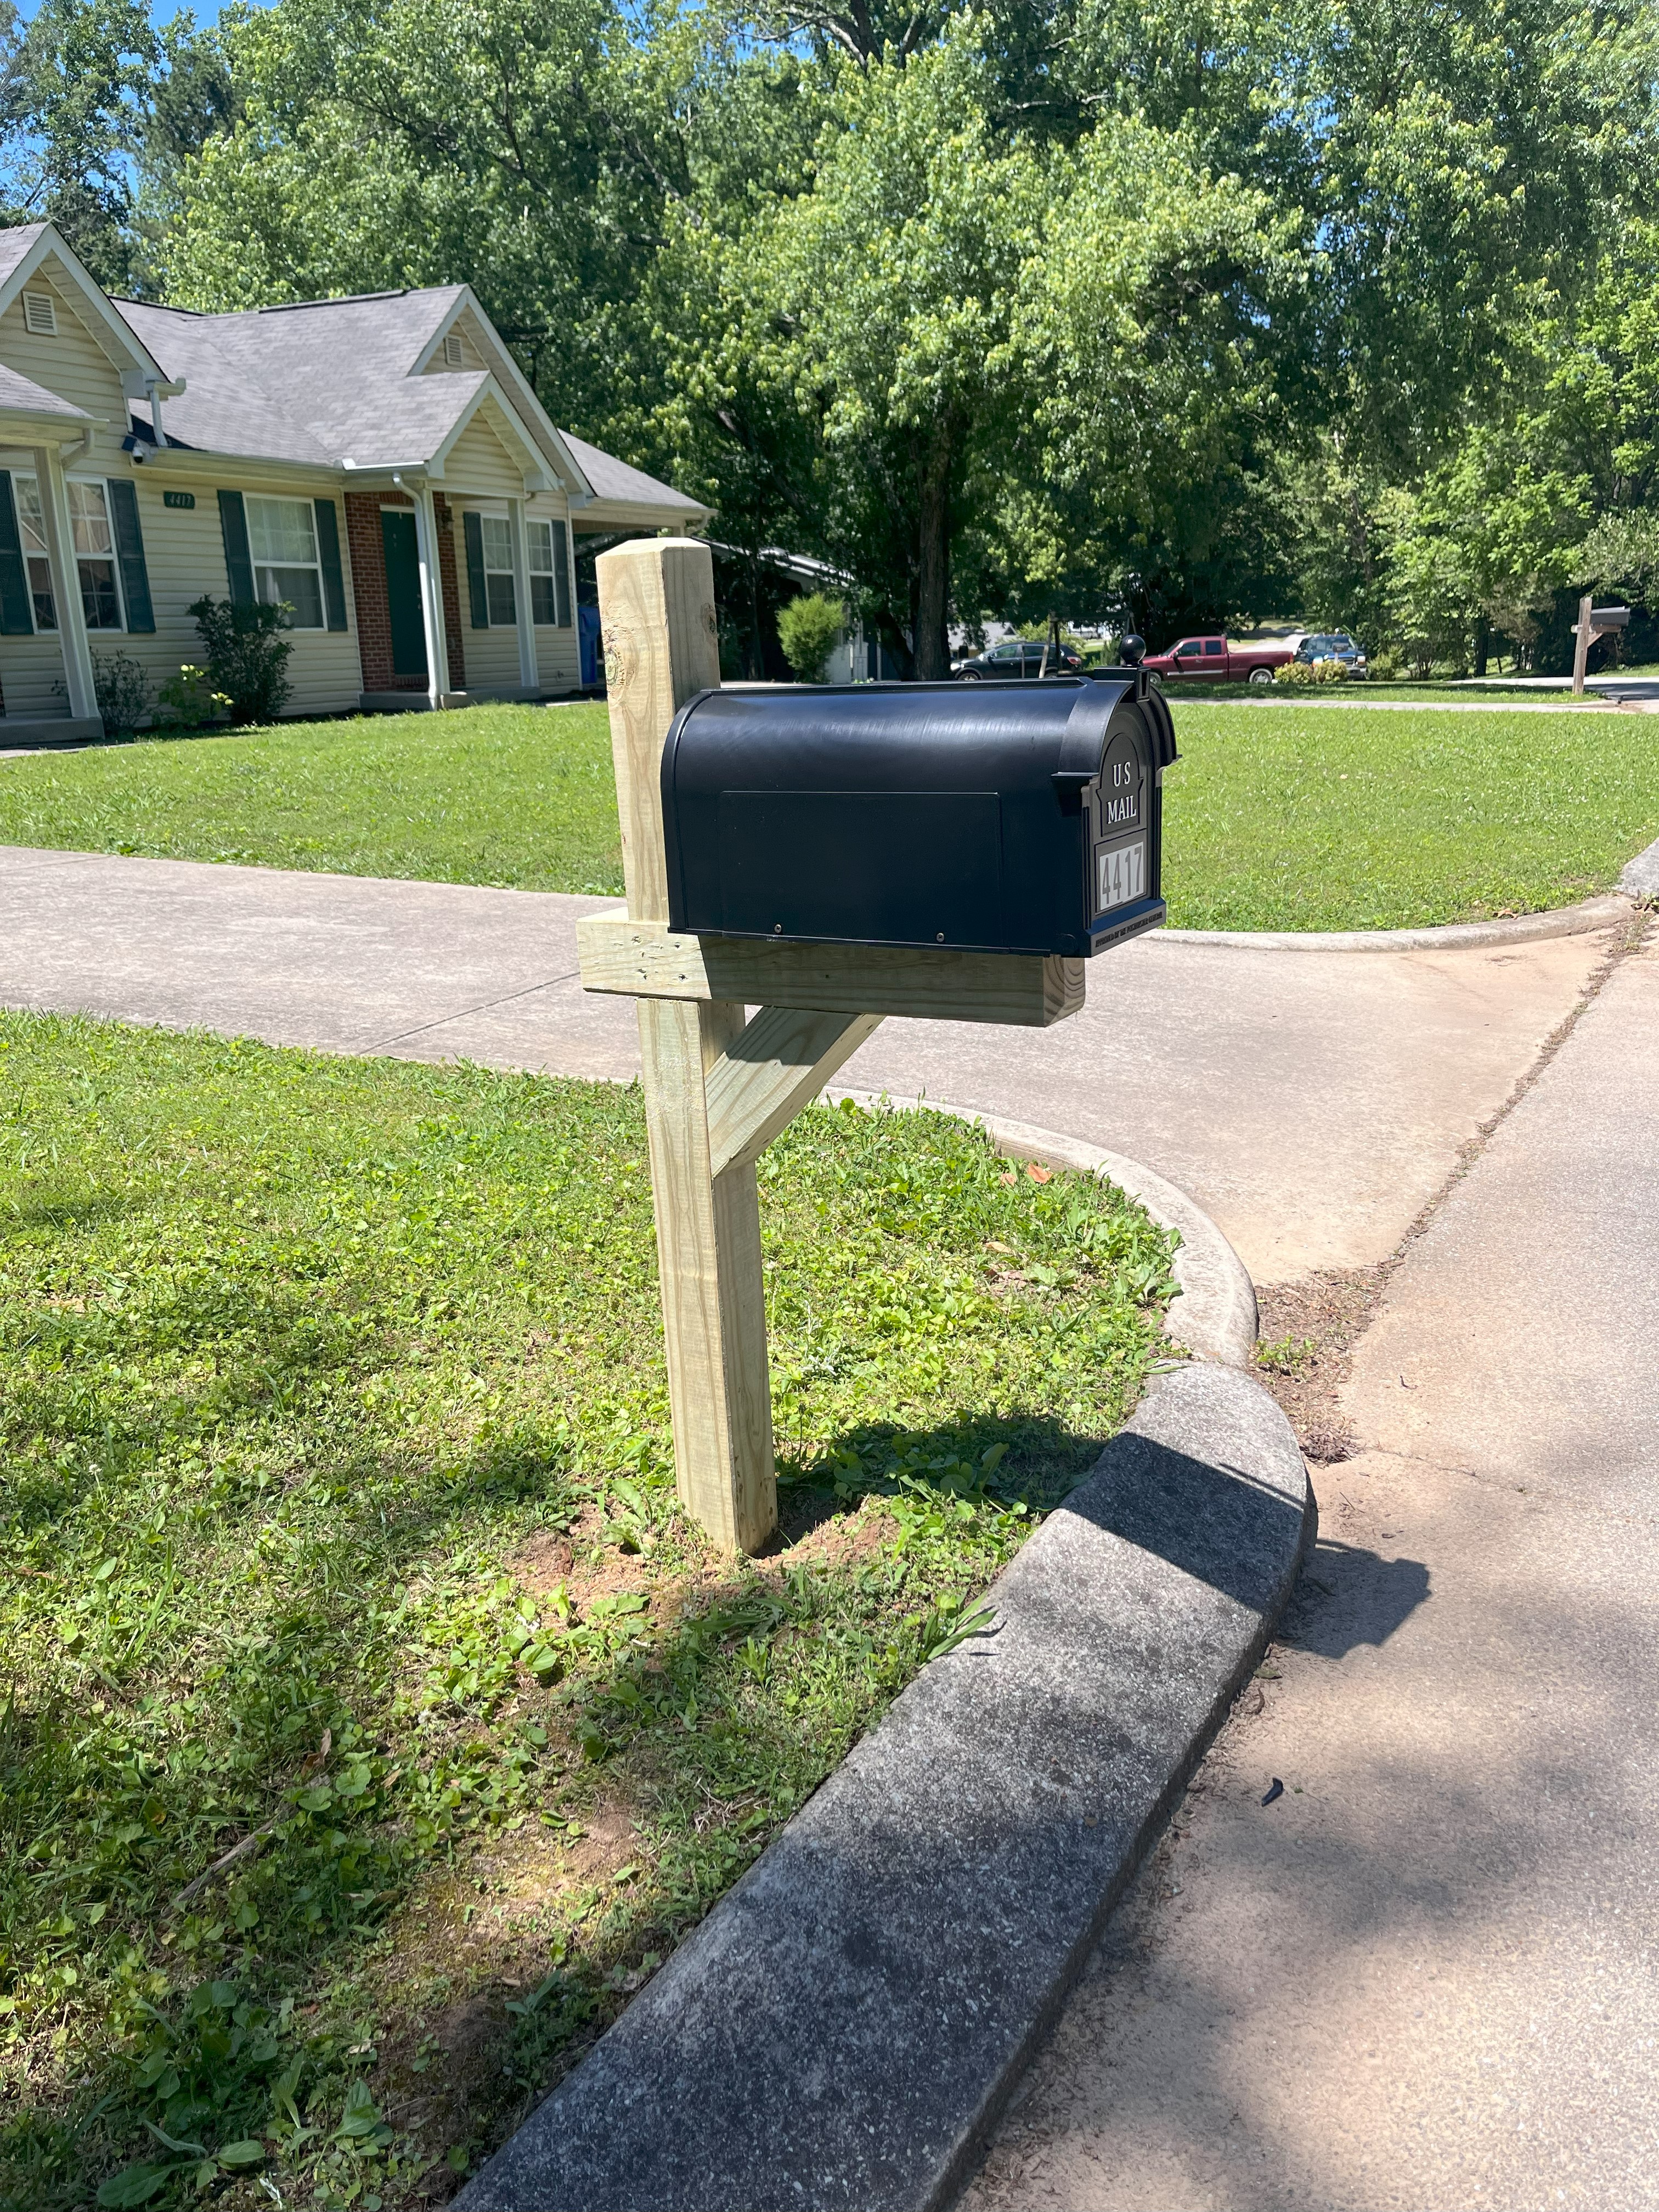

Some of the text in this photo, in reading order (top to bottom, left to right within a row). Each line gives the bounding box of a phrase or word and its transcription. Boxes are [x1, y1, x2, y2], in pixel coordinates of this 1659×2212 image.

[170, 494, 191, 506] 4417
[1113, 761, 1131, 787] US
[1107, 795, 1137, 824] MAIL
[1102, 845, 1142, 905] 4417
